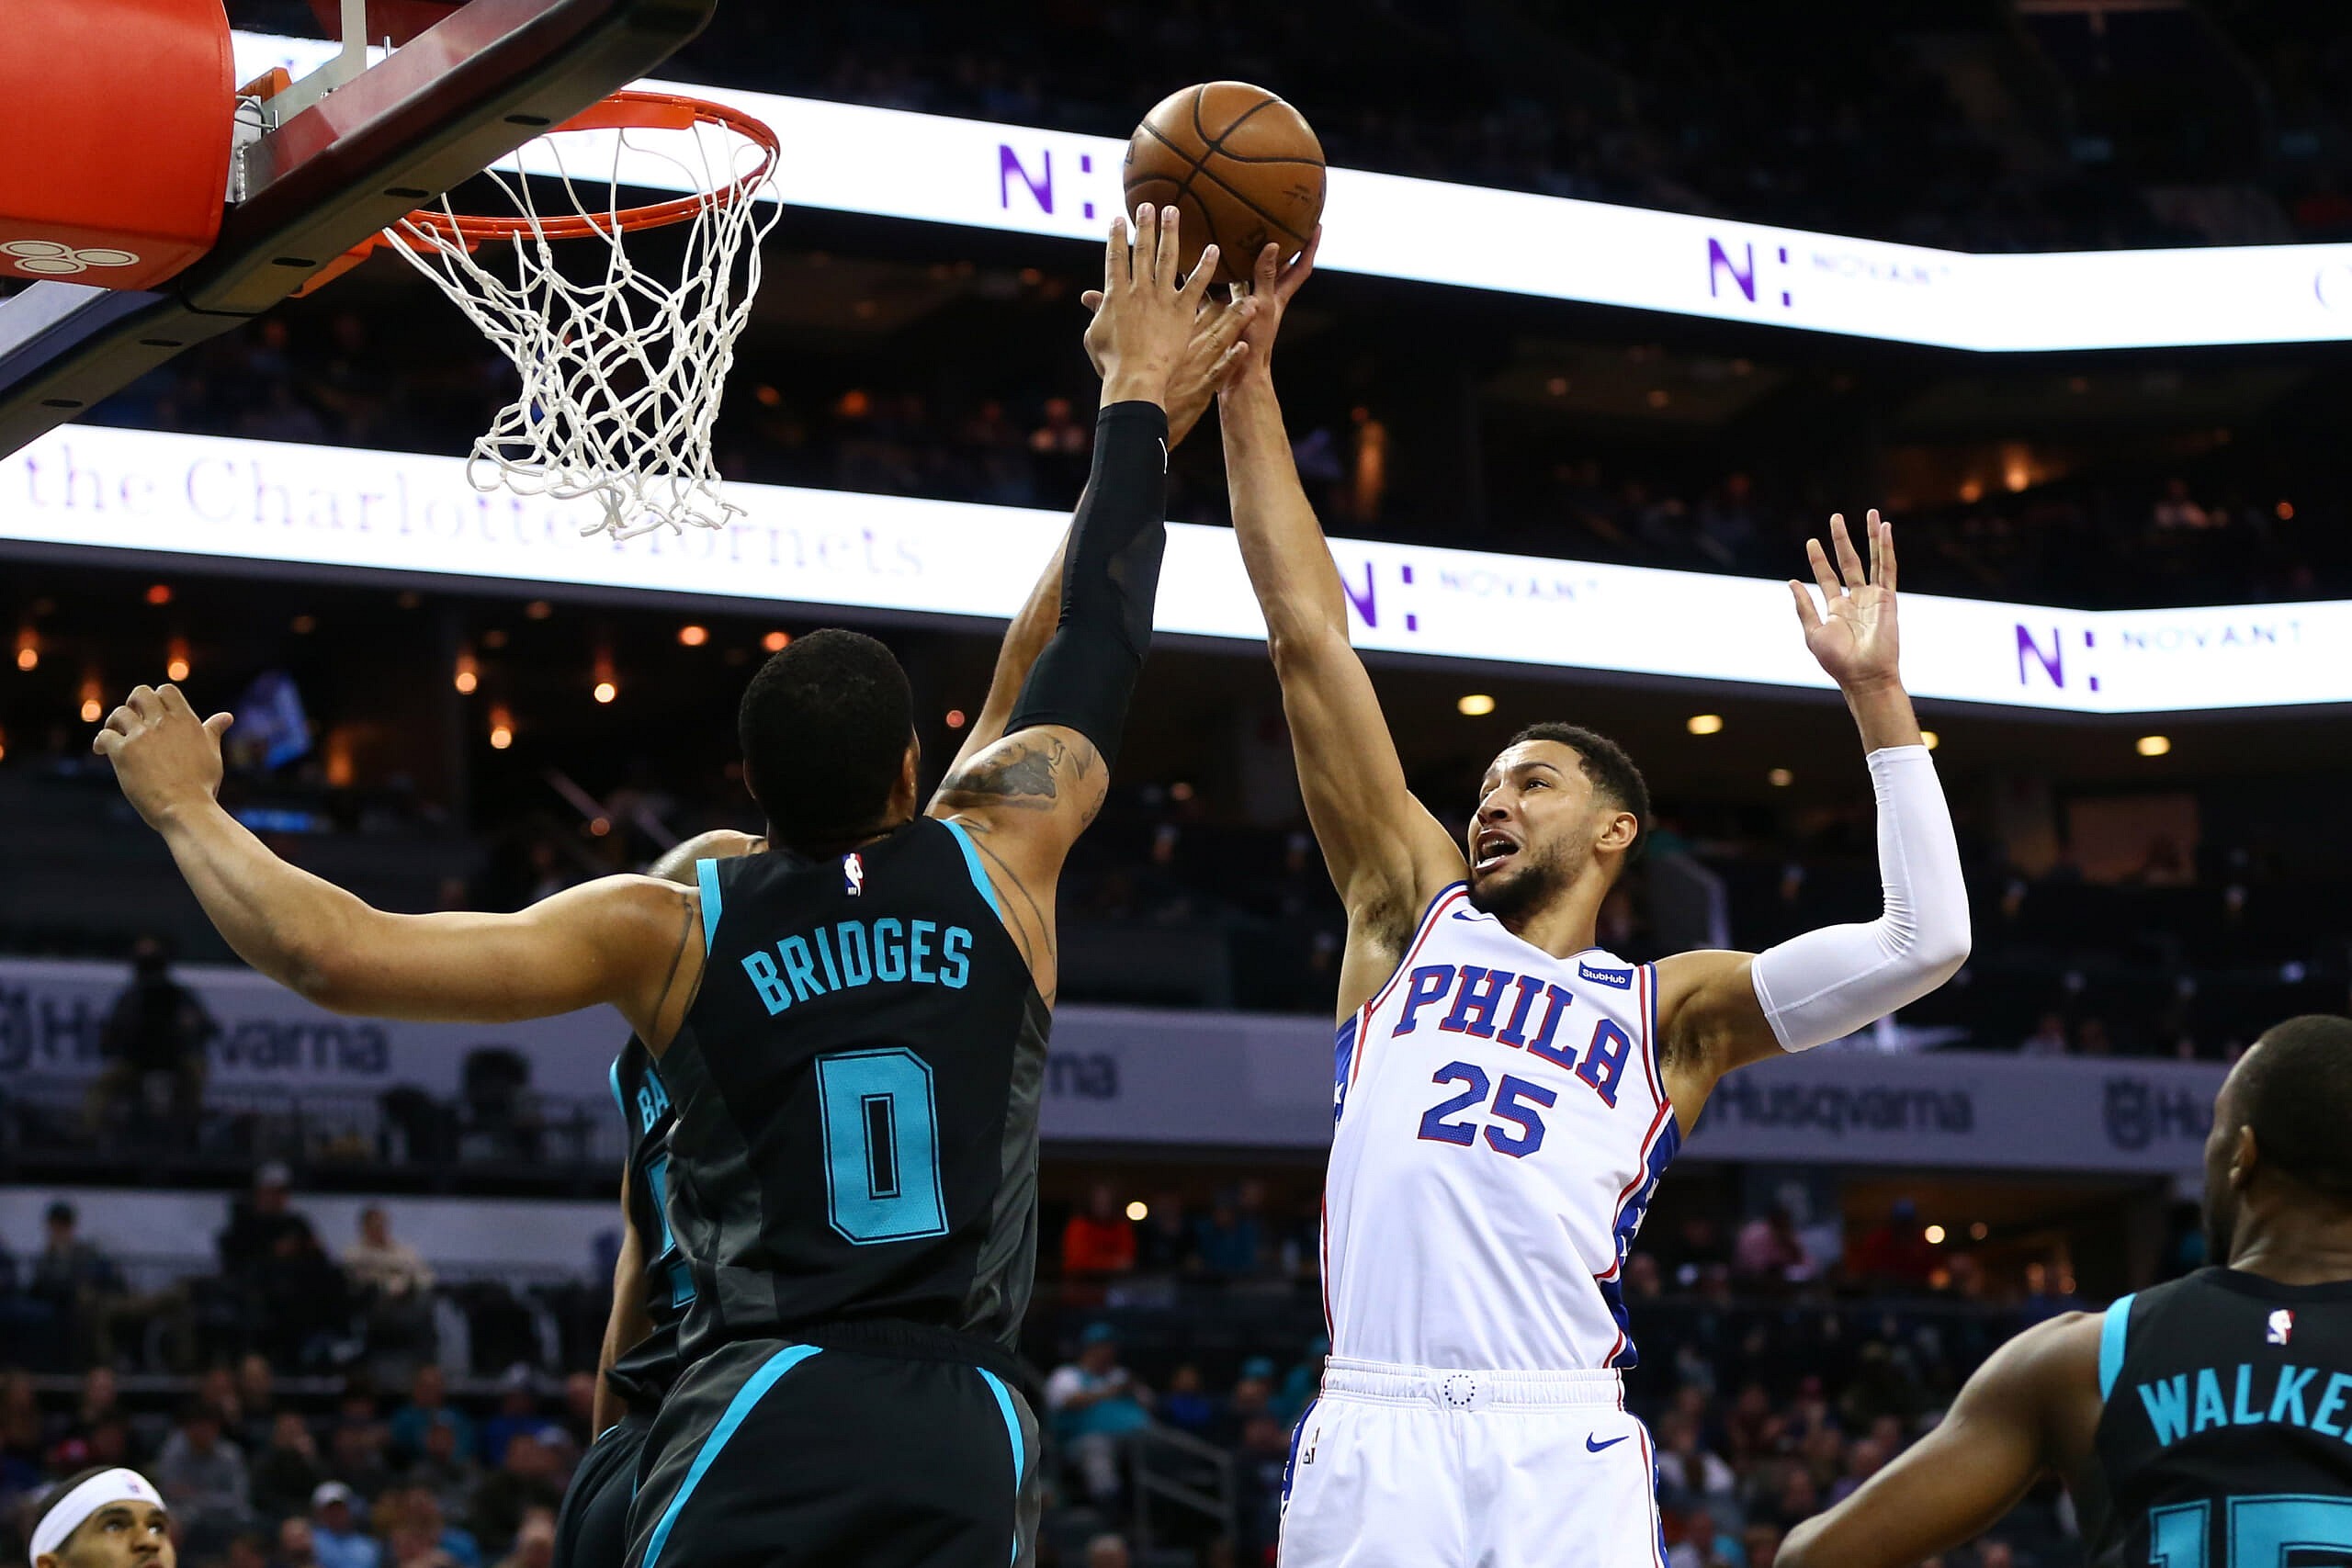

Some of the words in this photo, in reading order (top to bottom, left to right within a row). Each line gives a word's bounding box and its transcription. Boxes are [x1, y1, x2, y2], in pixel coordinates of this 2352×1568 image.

[24, 442, 156, 516] the
[185, 456, 577, 551] Charlotte
[2120, 617, 2303, 651] NOVANT
[741, 918, 973, 1016] BRIDGES
[1581, 968, 1626, 985] StubHub
[42, 998, 390, 1073] Hvarna
[1391, 964, 1631, 1109] PHILA
[815, 1046, 949, 1247] 0
[1418, 1061, 1557, 1158] 25
[2136, 1363, 2352, 1447] WALKE
